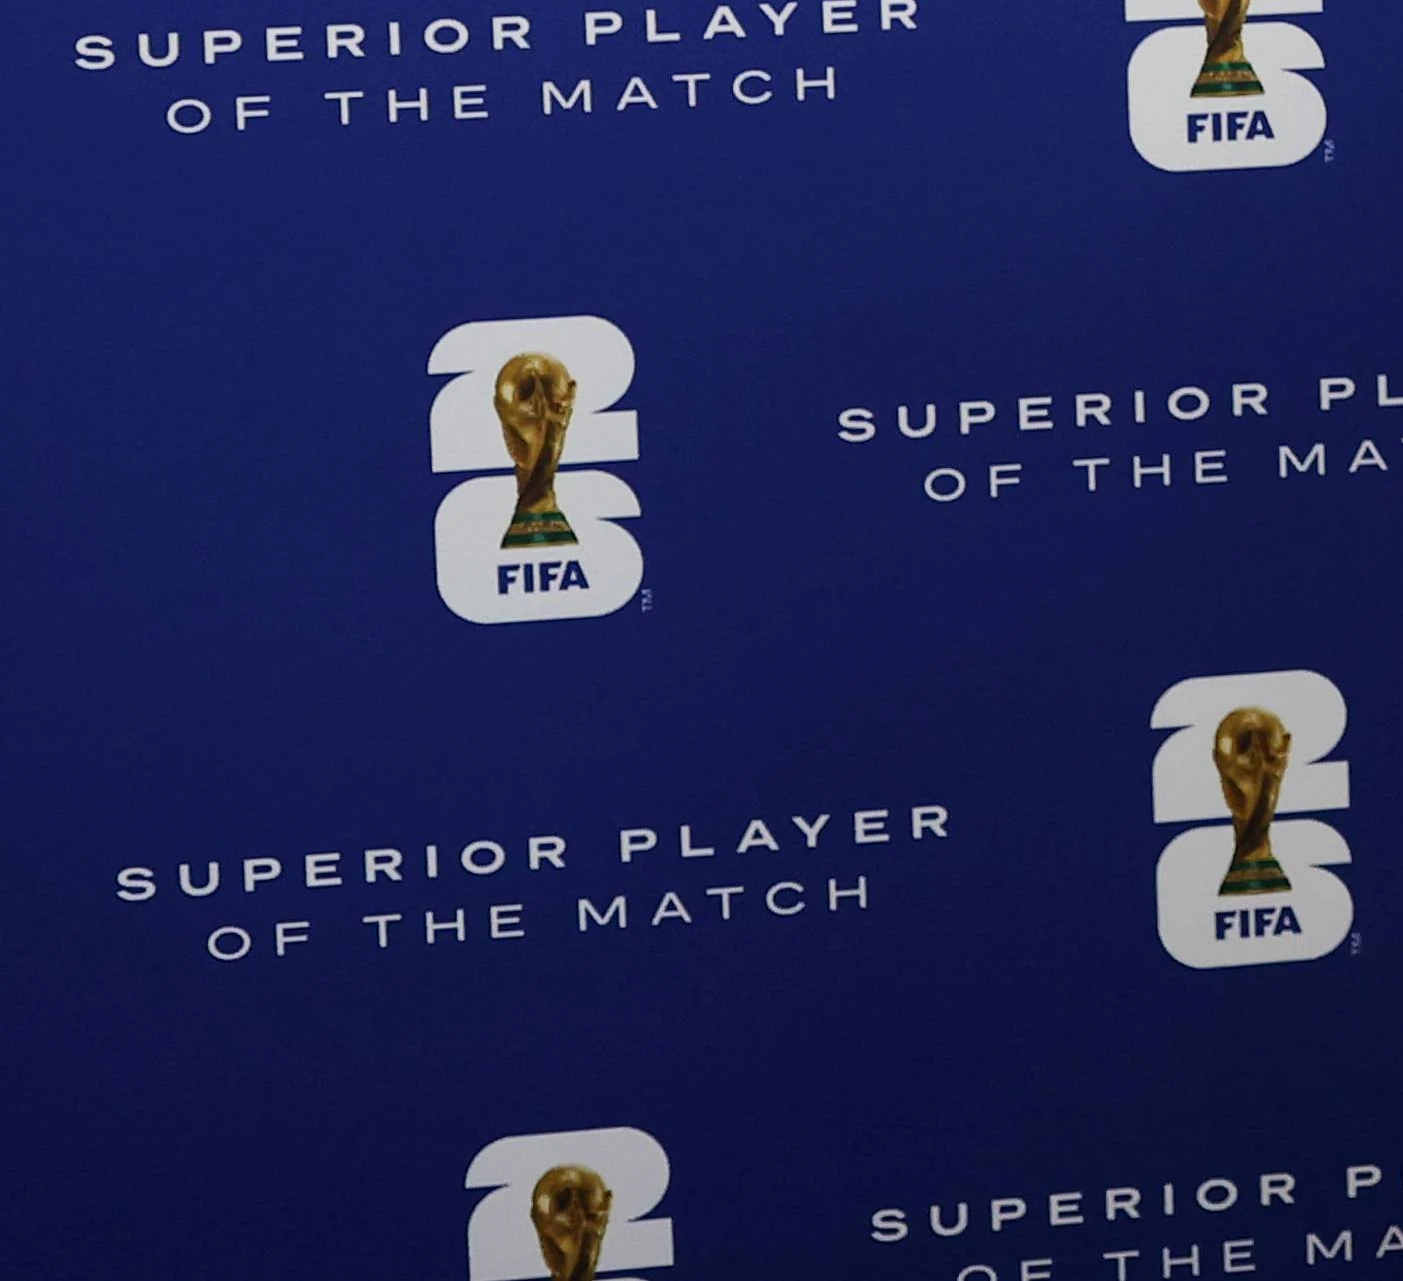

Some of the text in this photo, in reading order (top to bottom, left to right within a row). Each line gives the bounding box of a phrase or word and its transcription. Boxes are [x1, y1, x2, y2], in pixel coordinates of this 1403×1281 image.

[75, 15, 531, 70] SUPERIOR
[166, 66, 836, 134] OF THE MATCH
[1186, 109, 1276, 144] FIFA
[838, 382, 1268, 442] SUPERIOR
[924, 463, 1022, 502] OF
[1072, 449, 1228, 492] THE
[496, 559, 590, 596] FIFA
[116, 805, 948, 901] SUPERIOR PLAYER
[207, 875, 867, 961] OF THE MATCH
[1214, 905, 1303, 941] FIFA
[871, 1173, 1296, 1242] SUPERIOR
